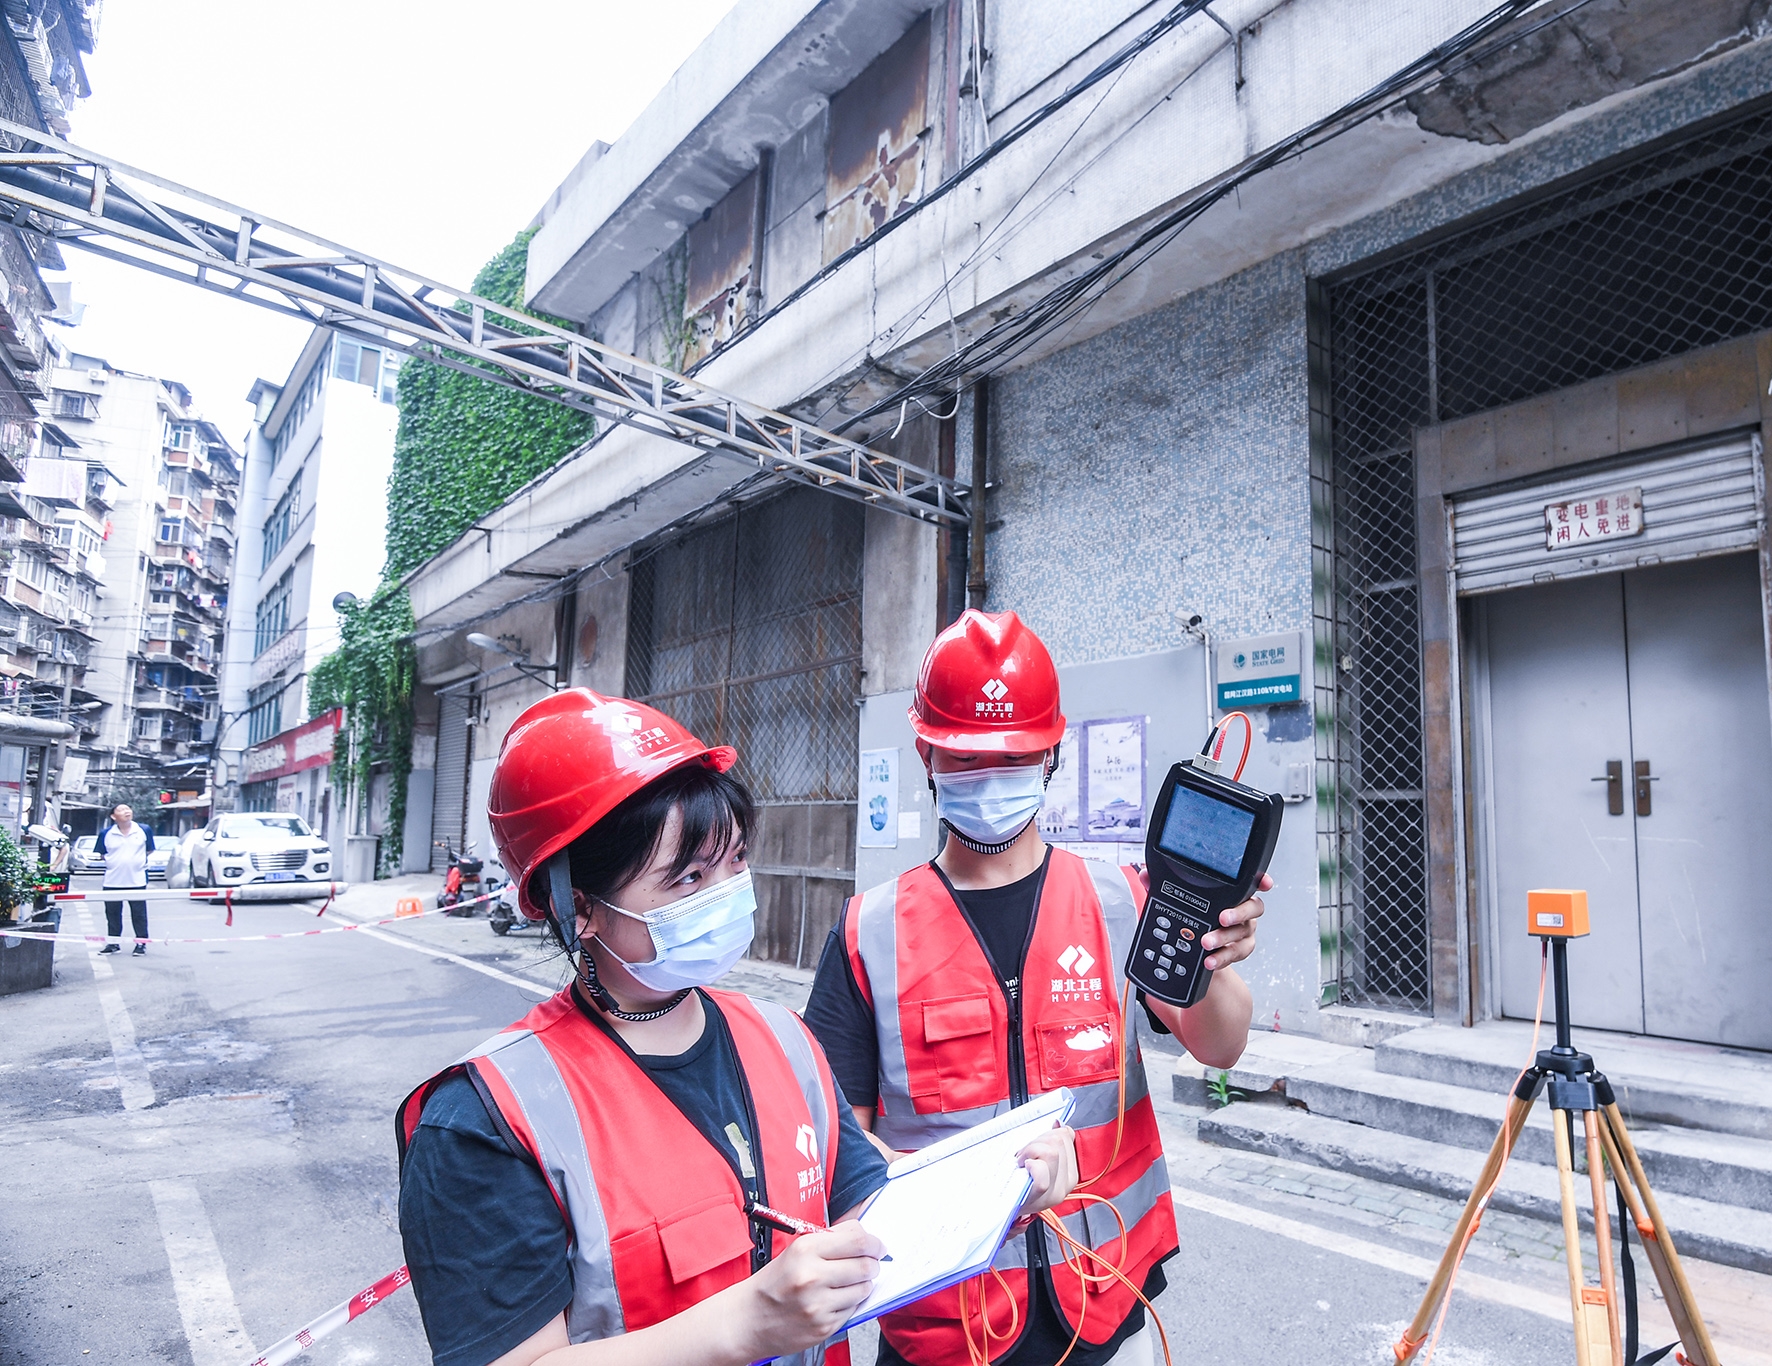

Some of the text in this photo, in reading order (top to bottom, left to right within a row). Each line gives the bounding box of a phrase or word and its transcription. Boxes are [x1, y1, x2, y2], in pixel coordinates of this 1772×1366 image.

[1556, 494, 1630, 524] 变电重地
[1557, 513, 1630, 543] 闲人免进
[1252, 647, 1285, 660] 国家电网
[975, 702, 1014, 712] 湖北工程
[627, 736, 671, 758] HYPEC
[1154, 903, 1182, 920] BHYT2010
[1051, 977, 1102, 992] 湖北工程
[1051, 992, 1102, 1002] HYPEC
[797, 1163, 823, 1189] 湖北工
